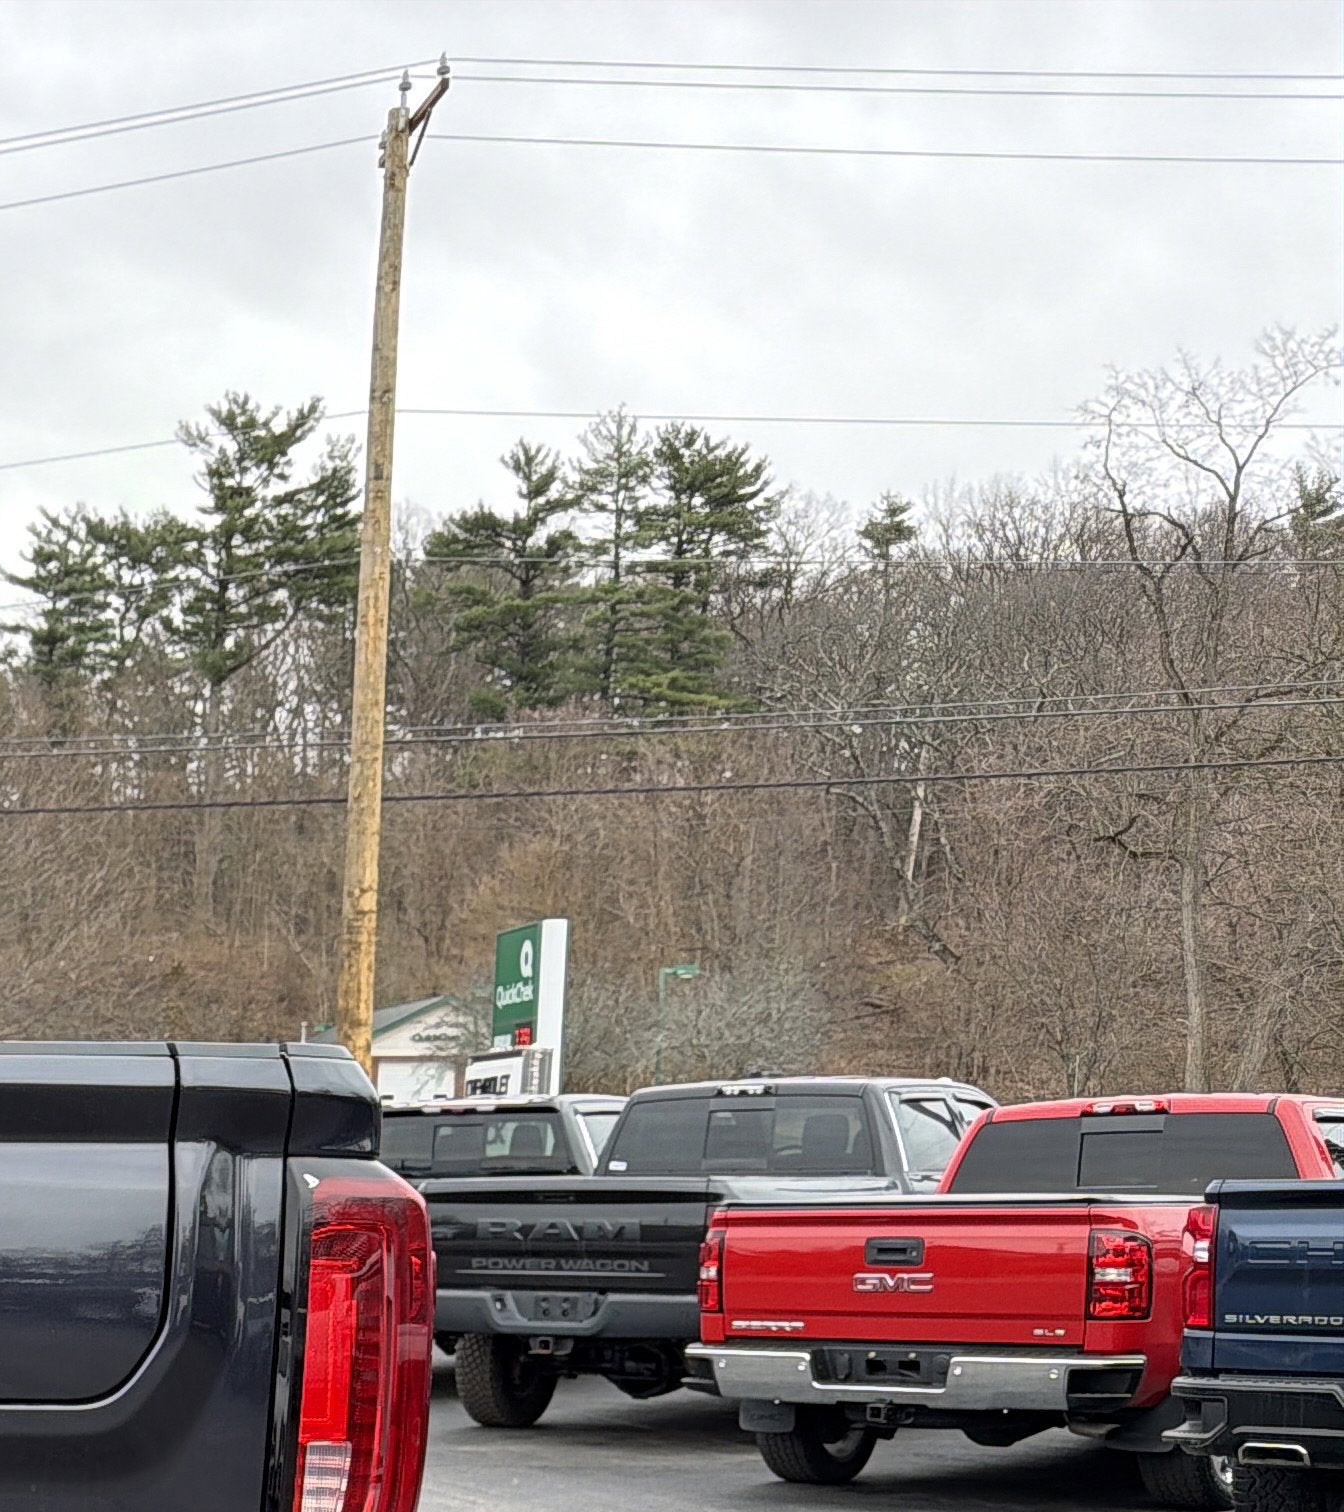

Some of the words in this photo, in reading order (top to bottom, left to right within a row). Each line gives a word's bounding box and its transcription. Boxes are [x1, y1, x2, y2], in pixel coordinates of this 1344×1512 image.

[476, 1218, 641, 1241] RAM
[471, 1257, 556, 1270] POWER
[561, 1258, 650, 1272] WAGON
[852, 1272, 934, 1293] GMC
[1224, 1314, 1344, 1326] SILVERADO
